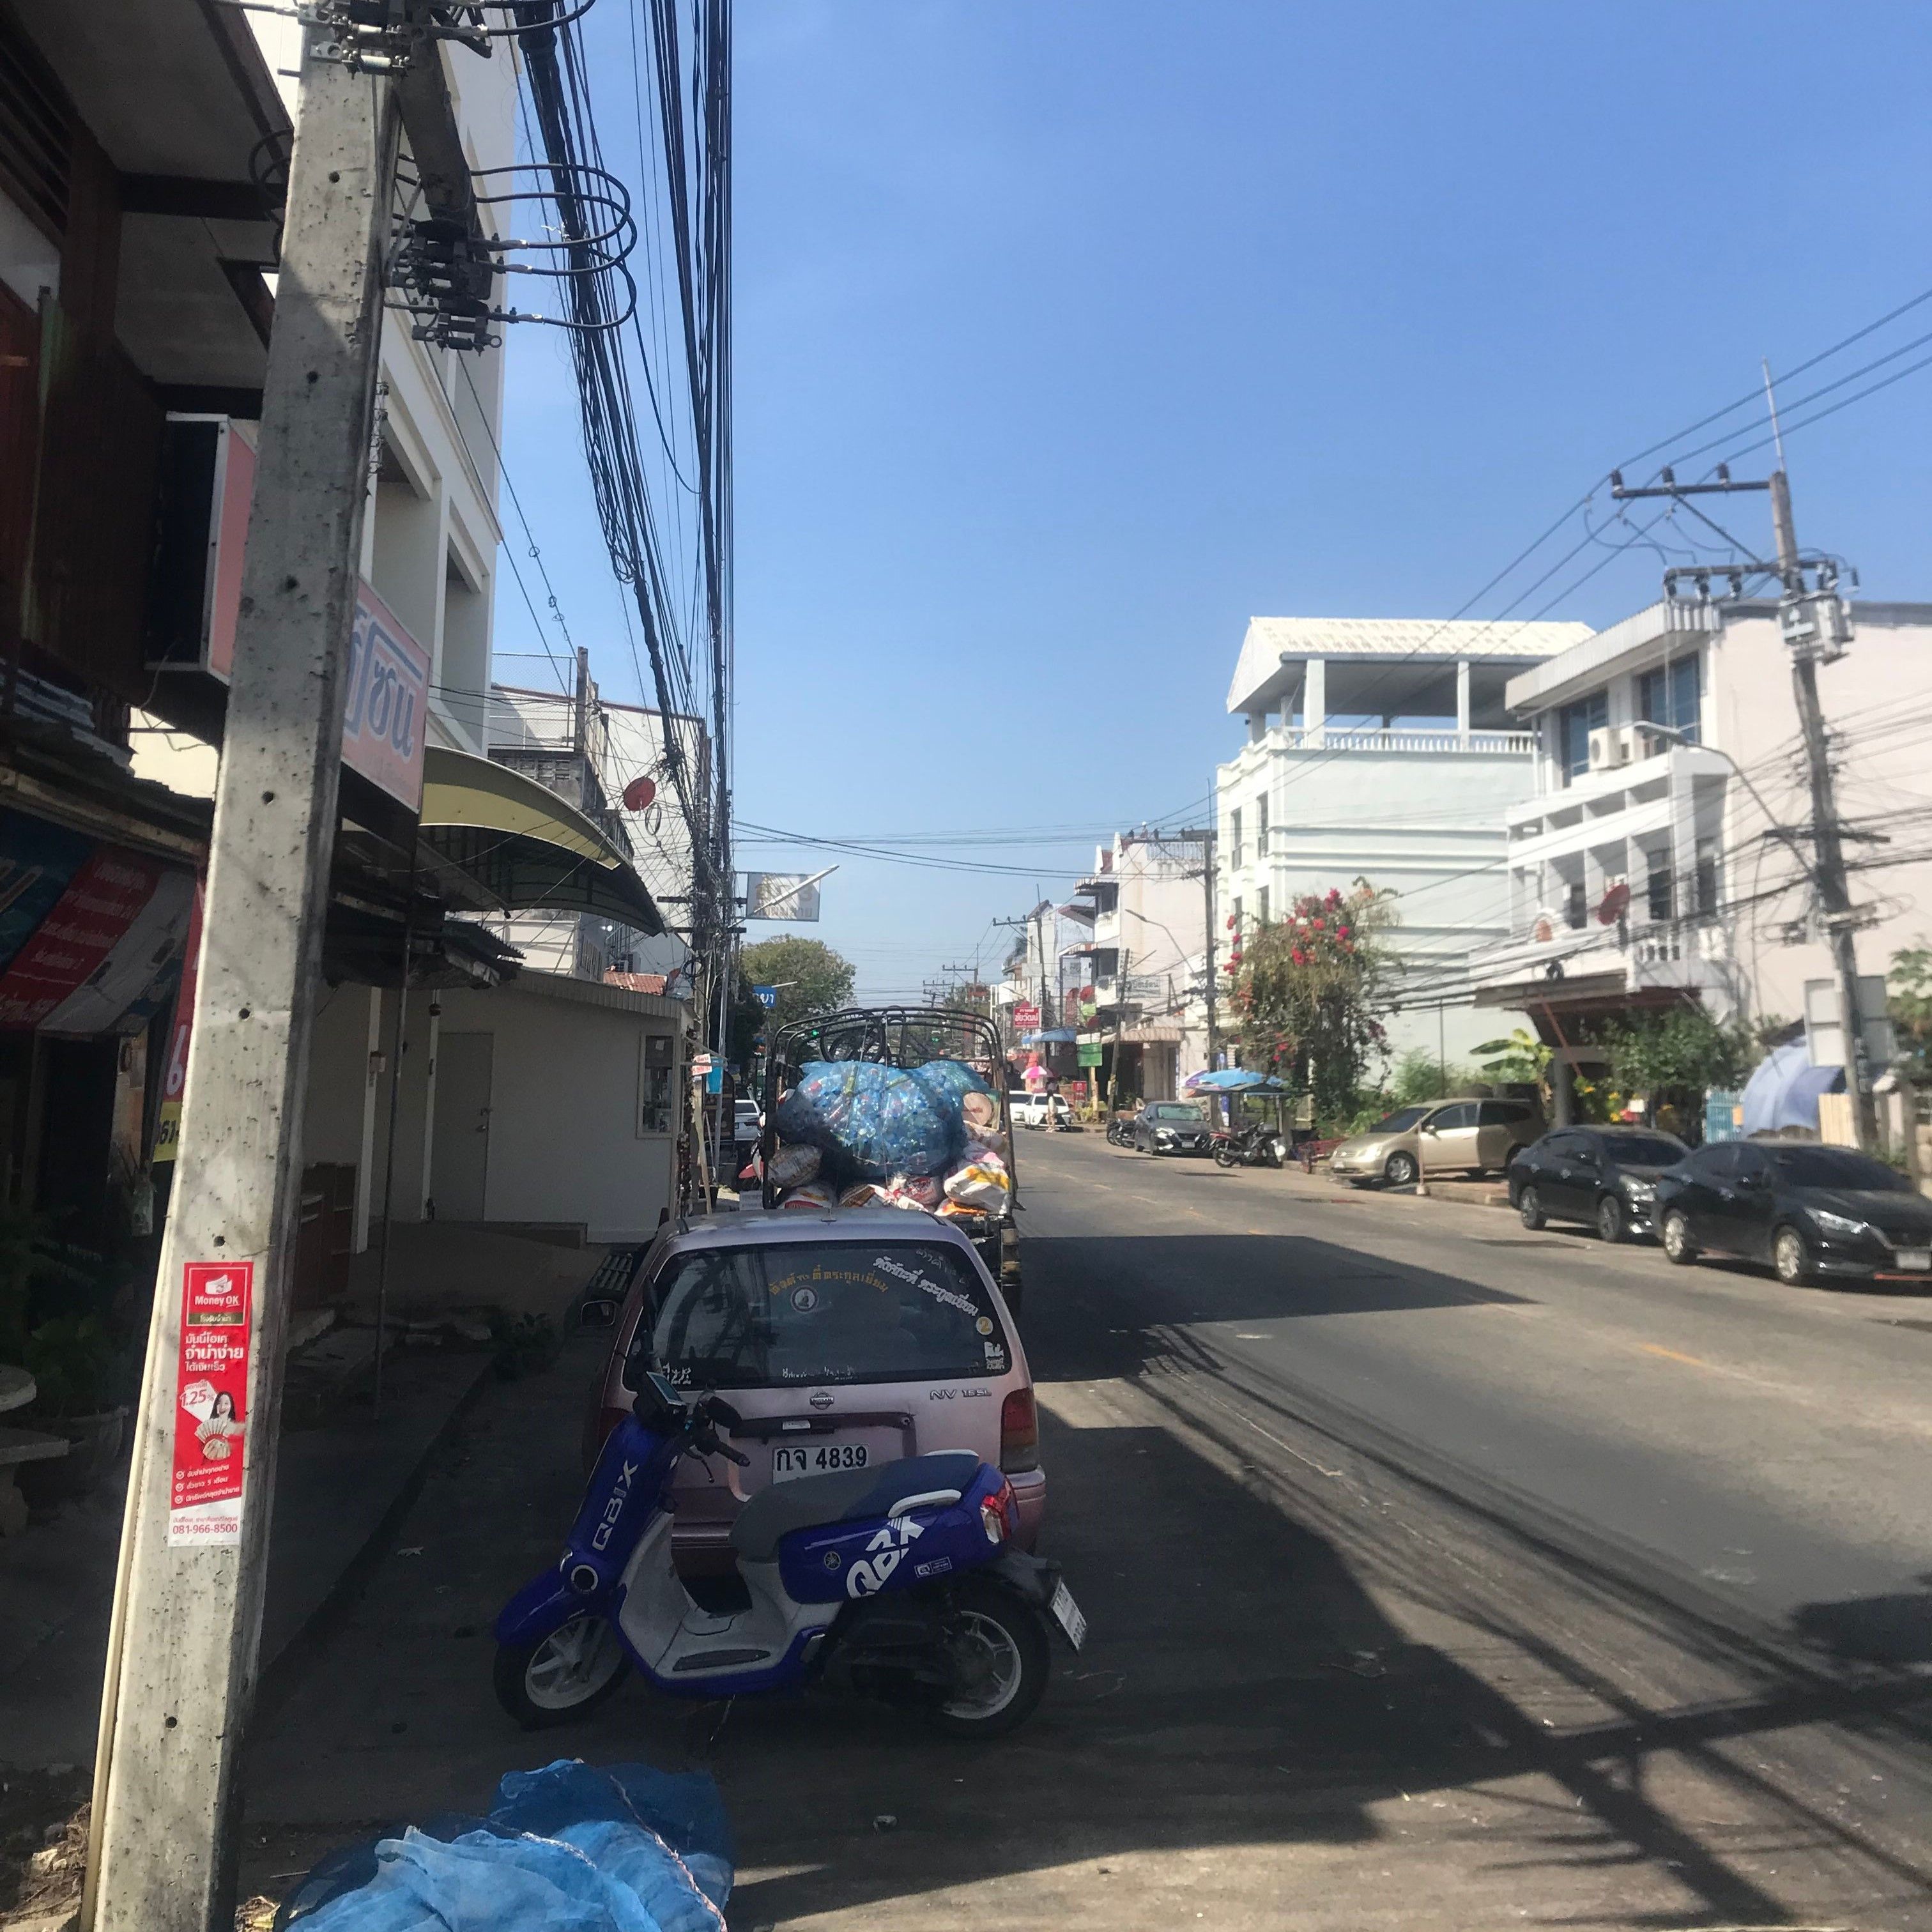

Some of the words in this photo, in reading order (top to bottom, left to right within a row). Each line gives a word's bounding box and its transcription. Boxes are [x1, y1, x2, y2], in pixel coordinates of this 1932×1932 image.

[194, 1295, 225, 1307] Money
[226, 1295, 240, 1306] OK
[185, 1344, 244, 1360] จำนำง่าย
[930, 1389, 957, 1400] NV
[776, 1448, 807, 1471] กจ
[816, 1446, 868, 1469] 4839
[592, 1460, 639, 1551] QBIX
[172, 1523, 238, 1535] 081-966-8500
